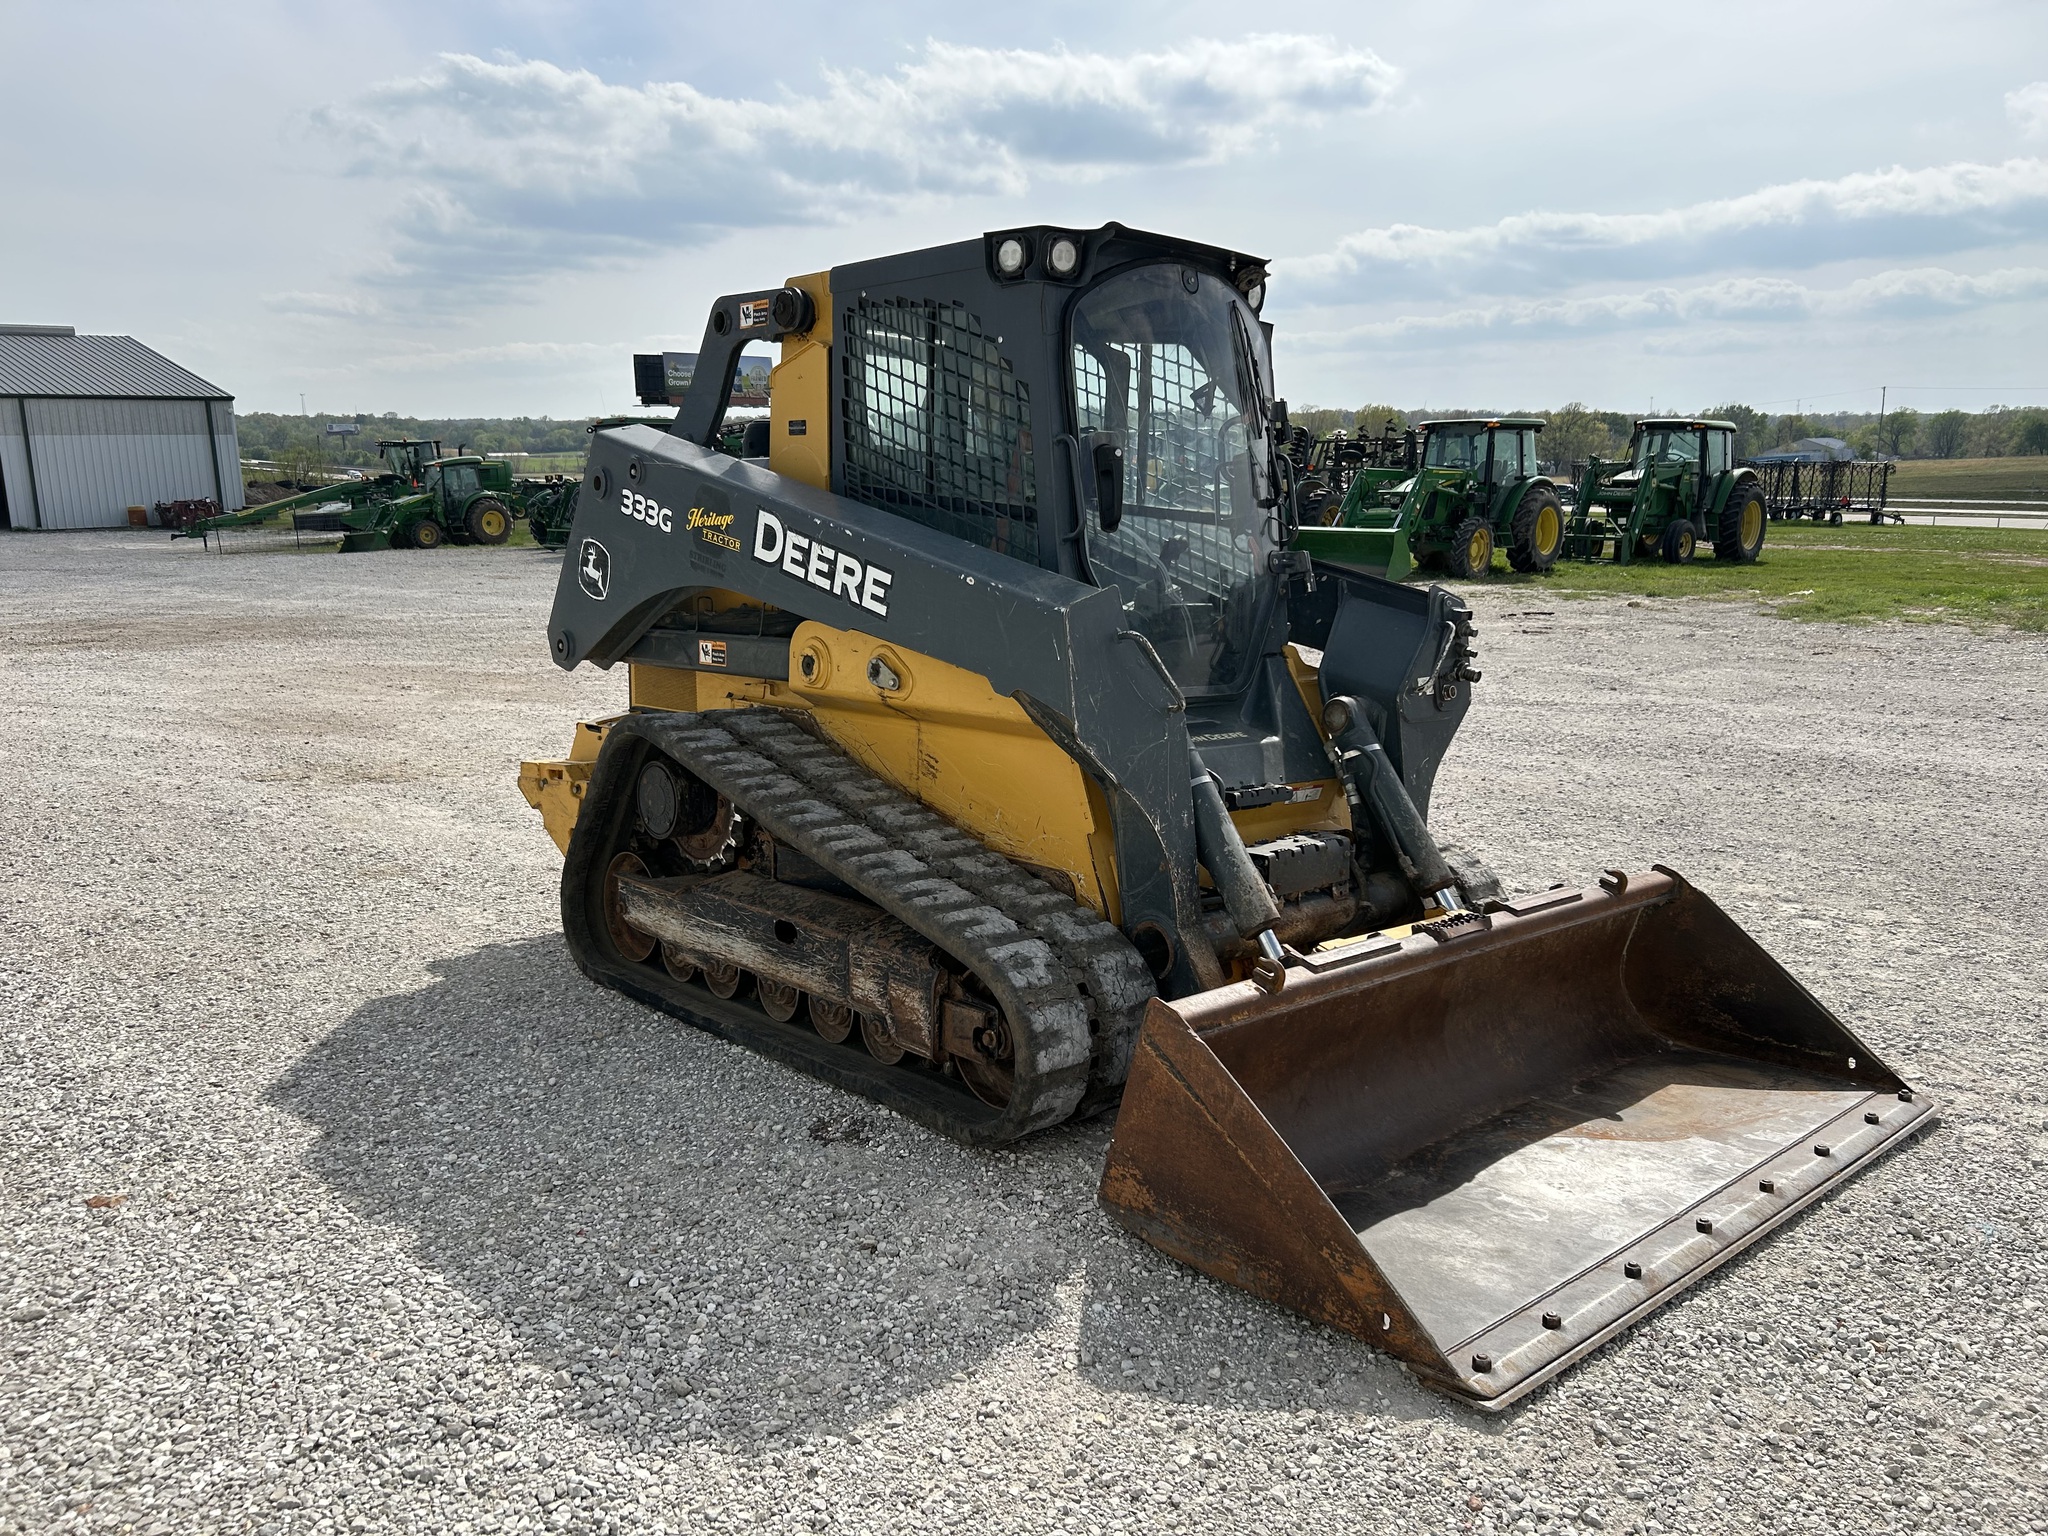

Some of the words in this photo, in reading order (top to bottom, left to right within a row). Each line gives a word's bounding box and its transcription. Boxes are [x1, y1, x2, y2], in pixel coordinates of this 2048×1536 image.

[667, 369, 691, 378] Choose
[668, 378, 689, 386] Grown
[620, 489, 673, 533] 333G
[686, 507, 735, 530] Heritage
[702, 530, 741, 550] TRACTOR
[753, 509, 893, 617] DEERE
[1204, 732, 1248, 741] DEERE
